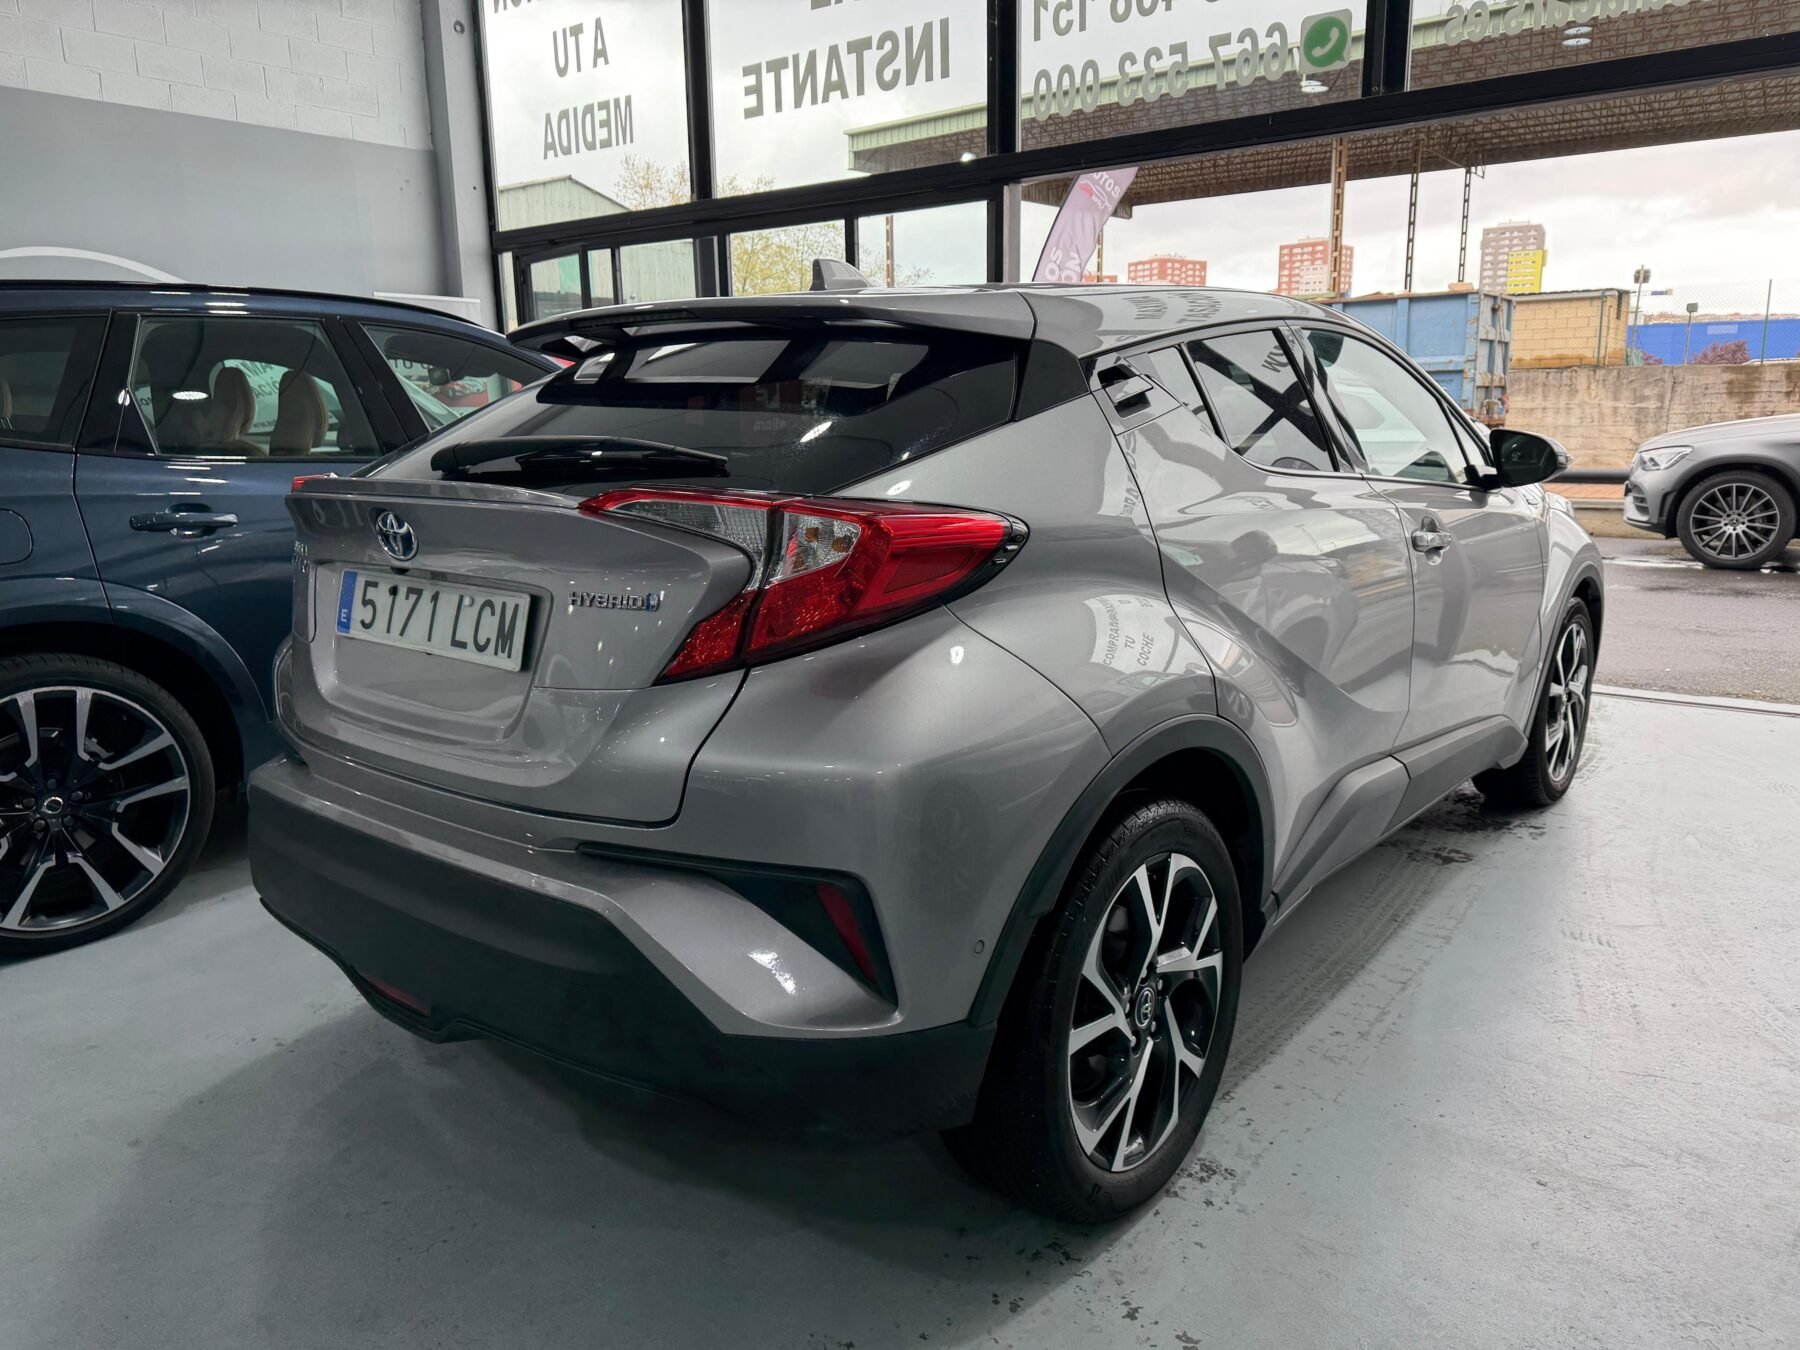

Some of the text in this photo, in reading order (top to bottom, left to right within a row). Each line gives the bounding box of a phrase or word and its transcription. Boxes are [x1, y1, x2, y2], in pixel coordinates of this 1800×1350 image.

[1090, 171, 1120, 198] UTOS
[568, 591, 645, 611] HYBRID
[360, 580, 520, 659] 5171 LCM
